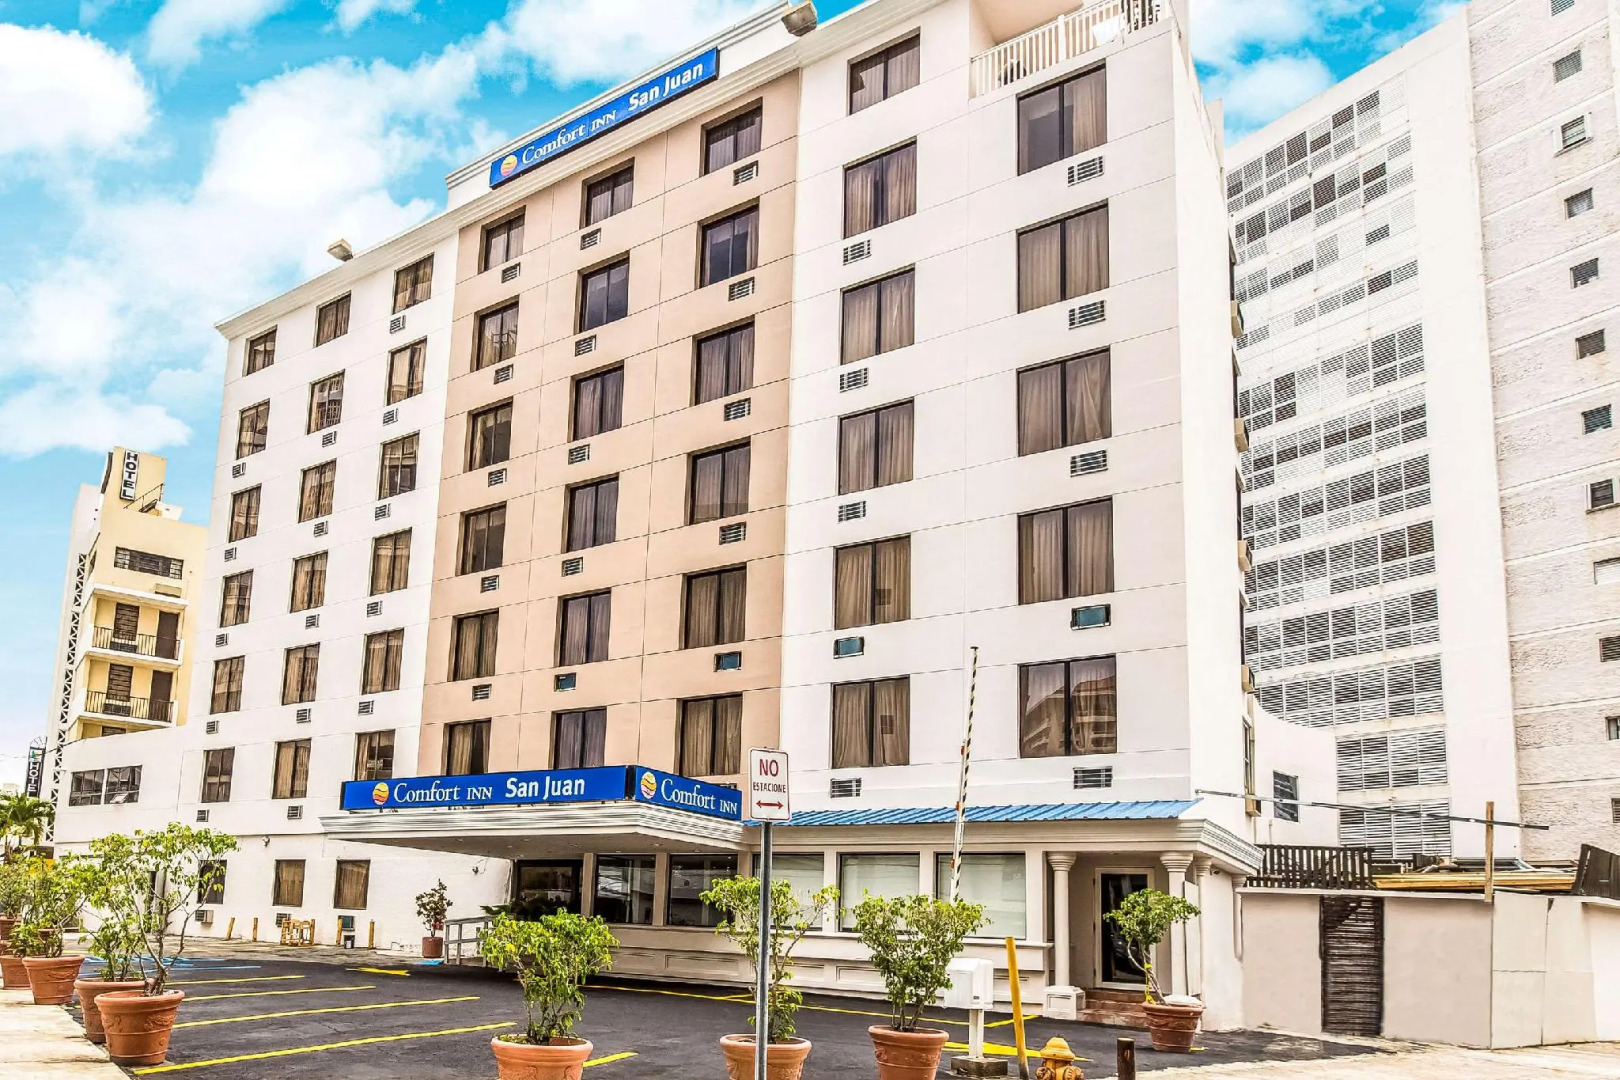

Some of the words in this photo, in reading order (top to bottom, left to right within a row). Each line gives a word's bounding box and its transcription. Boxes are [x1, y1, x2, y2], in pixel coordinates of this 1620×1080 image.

[522, 128, 587, 164] Comfort
[590, 110, 616, 131] INN
[628, 87, 659, 111] San
[663, 63, 703, 96] Juan
[122, 452, 138, 498] HOTEL
[27, 761, 39, 798] HOTEL
[759, 759, 779, 777] NO
[393, 780, 461, 803] Comfort
[466, 786, 493, 800] INN
[505, 777, 539, 798] San
[543, 776, 585, 800] Juan
[661, 778, 716, 810] Comfort
[719, 799, 738, 815] INN
[753, 782, 786, 793] ESTACIONE
